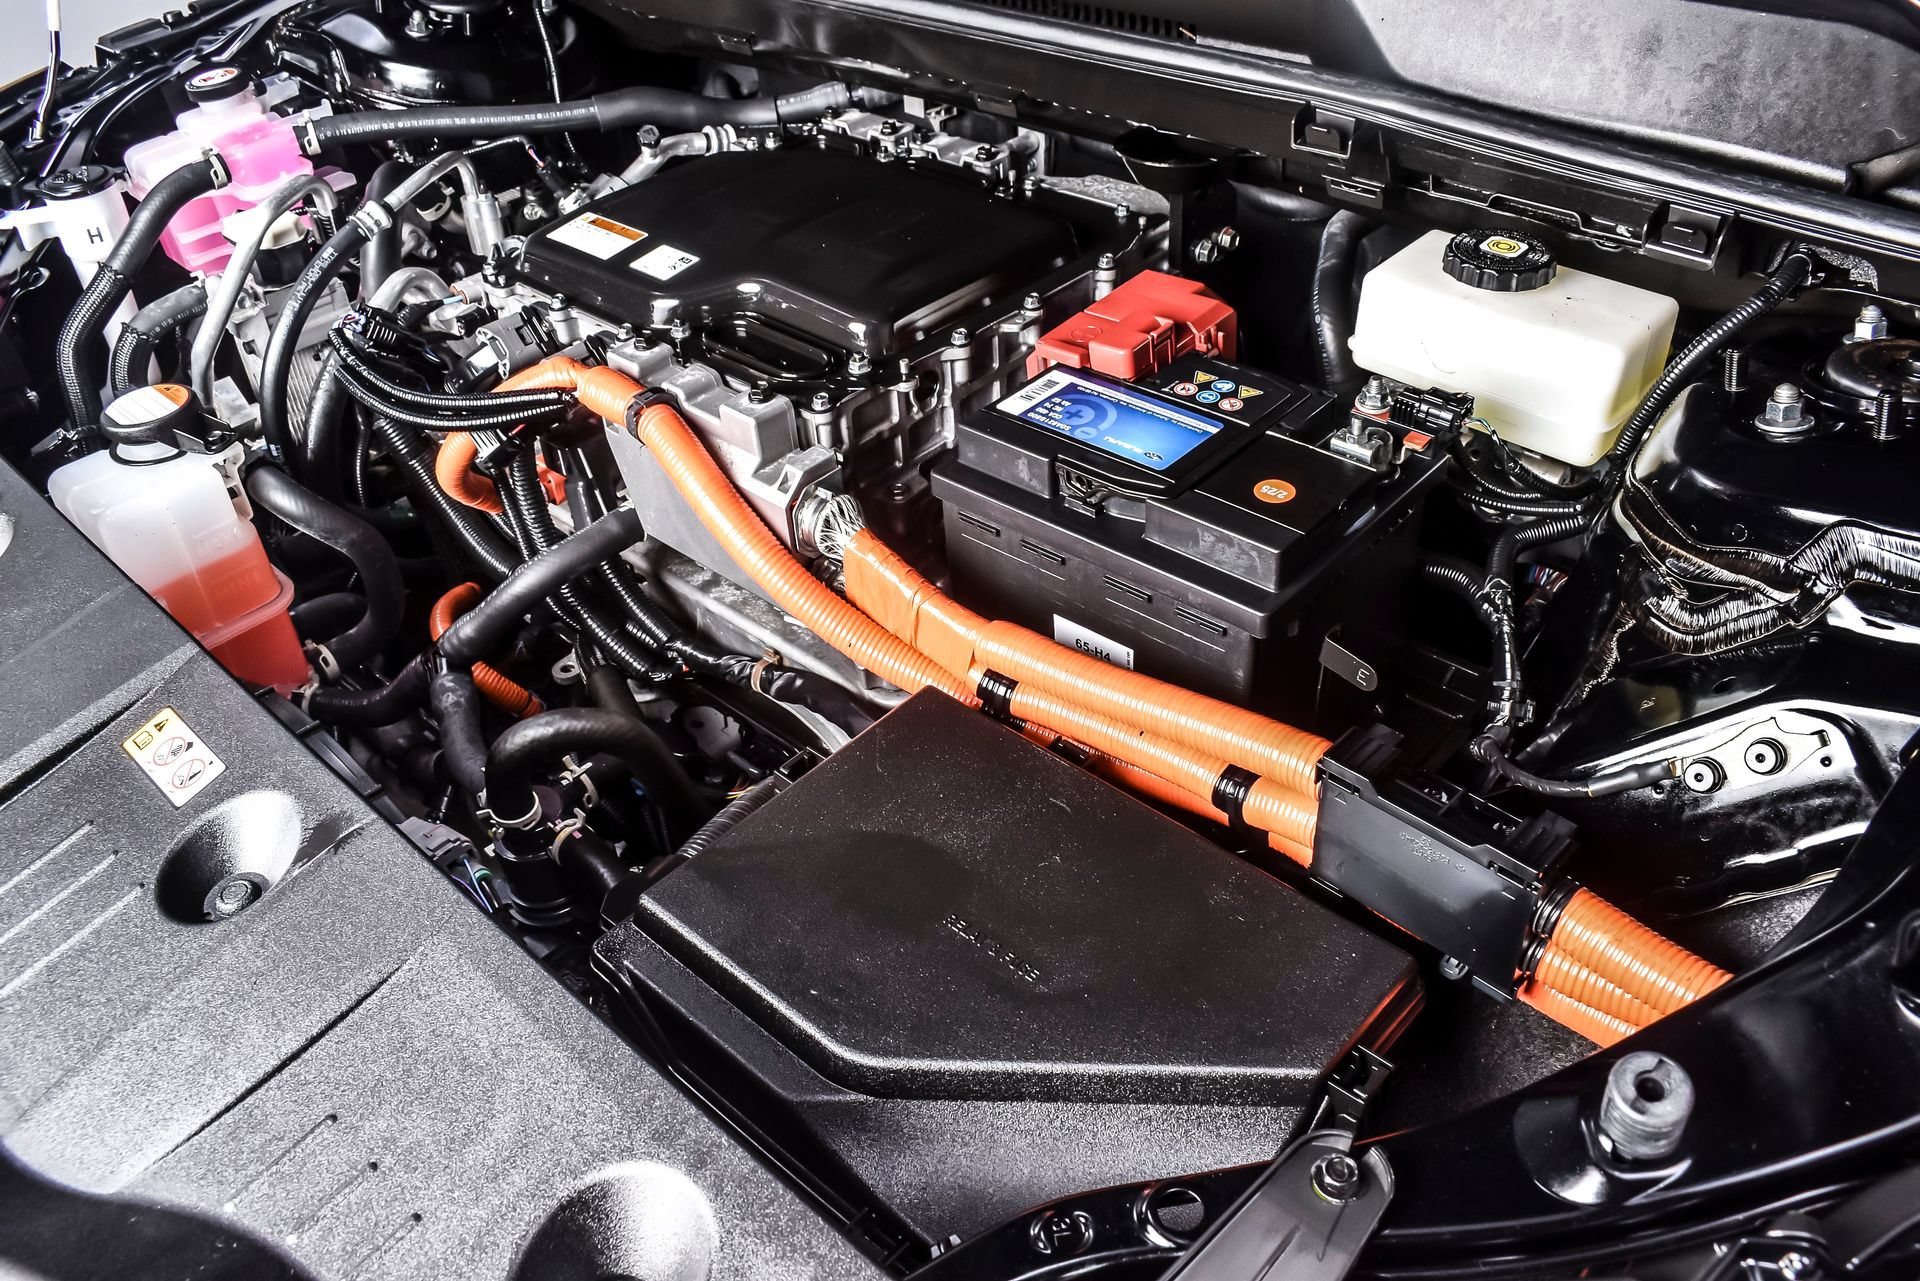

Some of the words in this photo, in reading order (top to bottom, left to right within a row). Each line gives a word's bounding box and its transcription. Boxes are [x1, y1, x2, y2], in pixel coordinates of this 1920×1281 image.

[86, 226, 104, 244] H
[1103, 435, 1144, 454] SUBARU
[1260, 484, 1288, 499] 2/25
[1075, 638, 1111, 662] 65-H4
